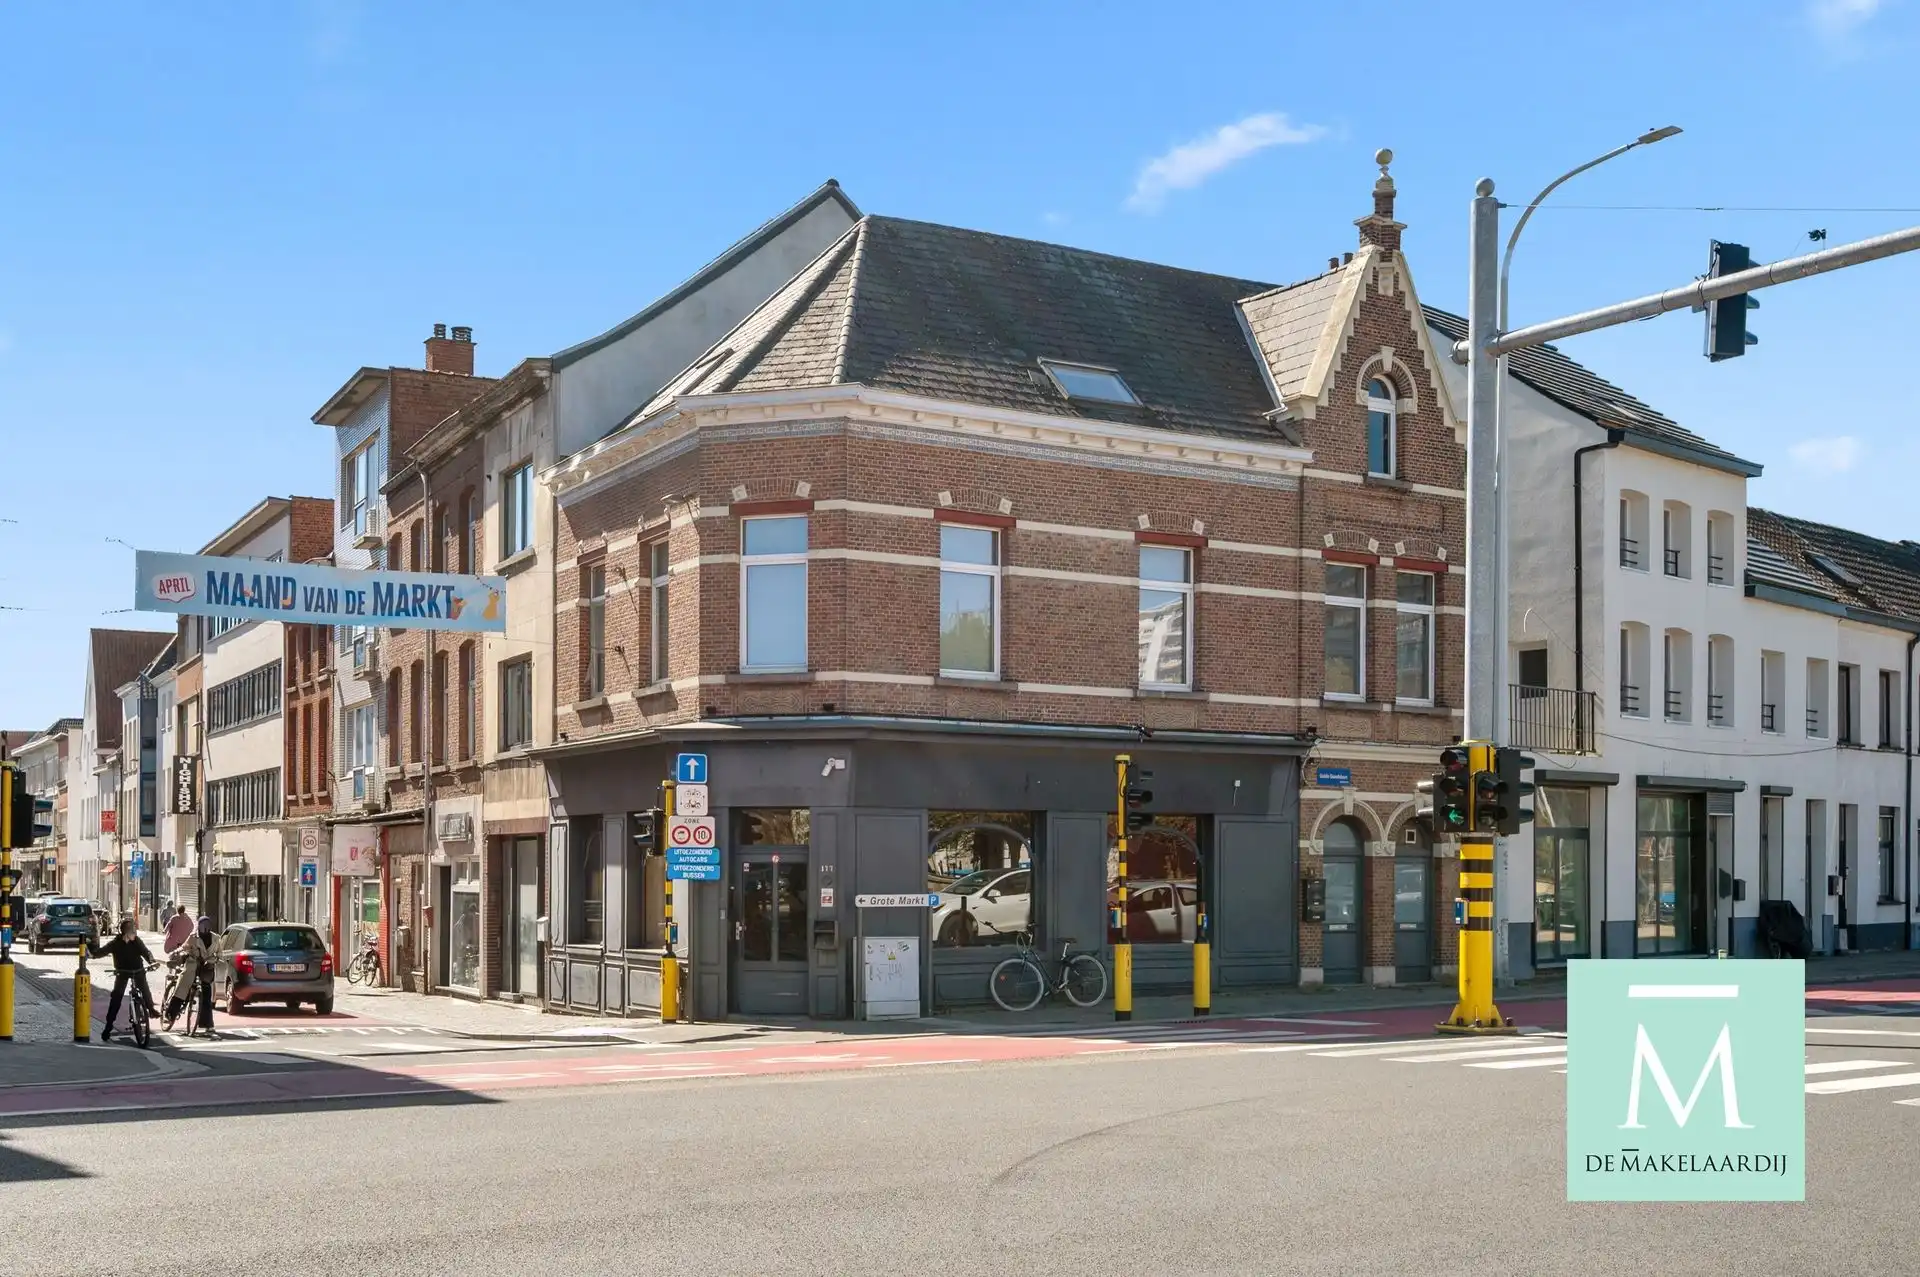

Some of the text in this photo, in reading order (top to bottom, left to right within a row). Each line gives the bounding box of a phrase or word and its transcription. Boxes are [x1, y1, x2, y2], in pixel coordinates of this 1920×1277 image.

[158, 576, 191, 594] APRIL
[206, 571, 455, 619] MAAND VAN DE MARKT
[178, 757, 192, 813] NIGHTSHOP
